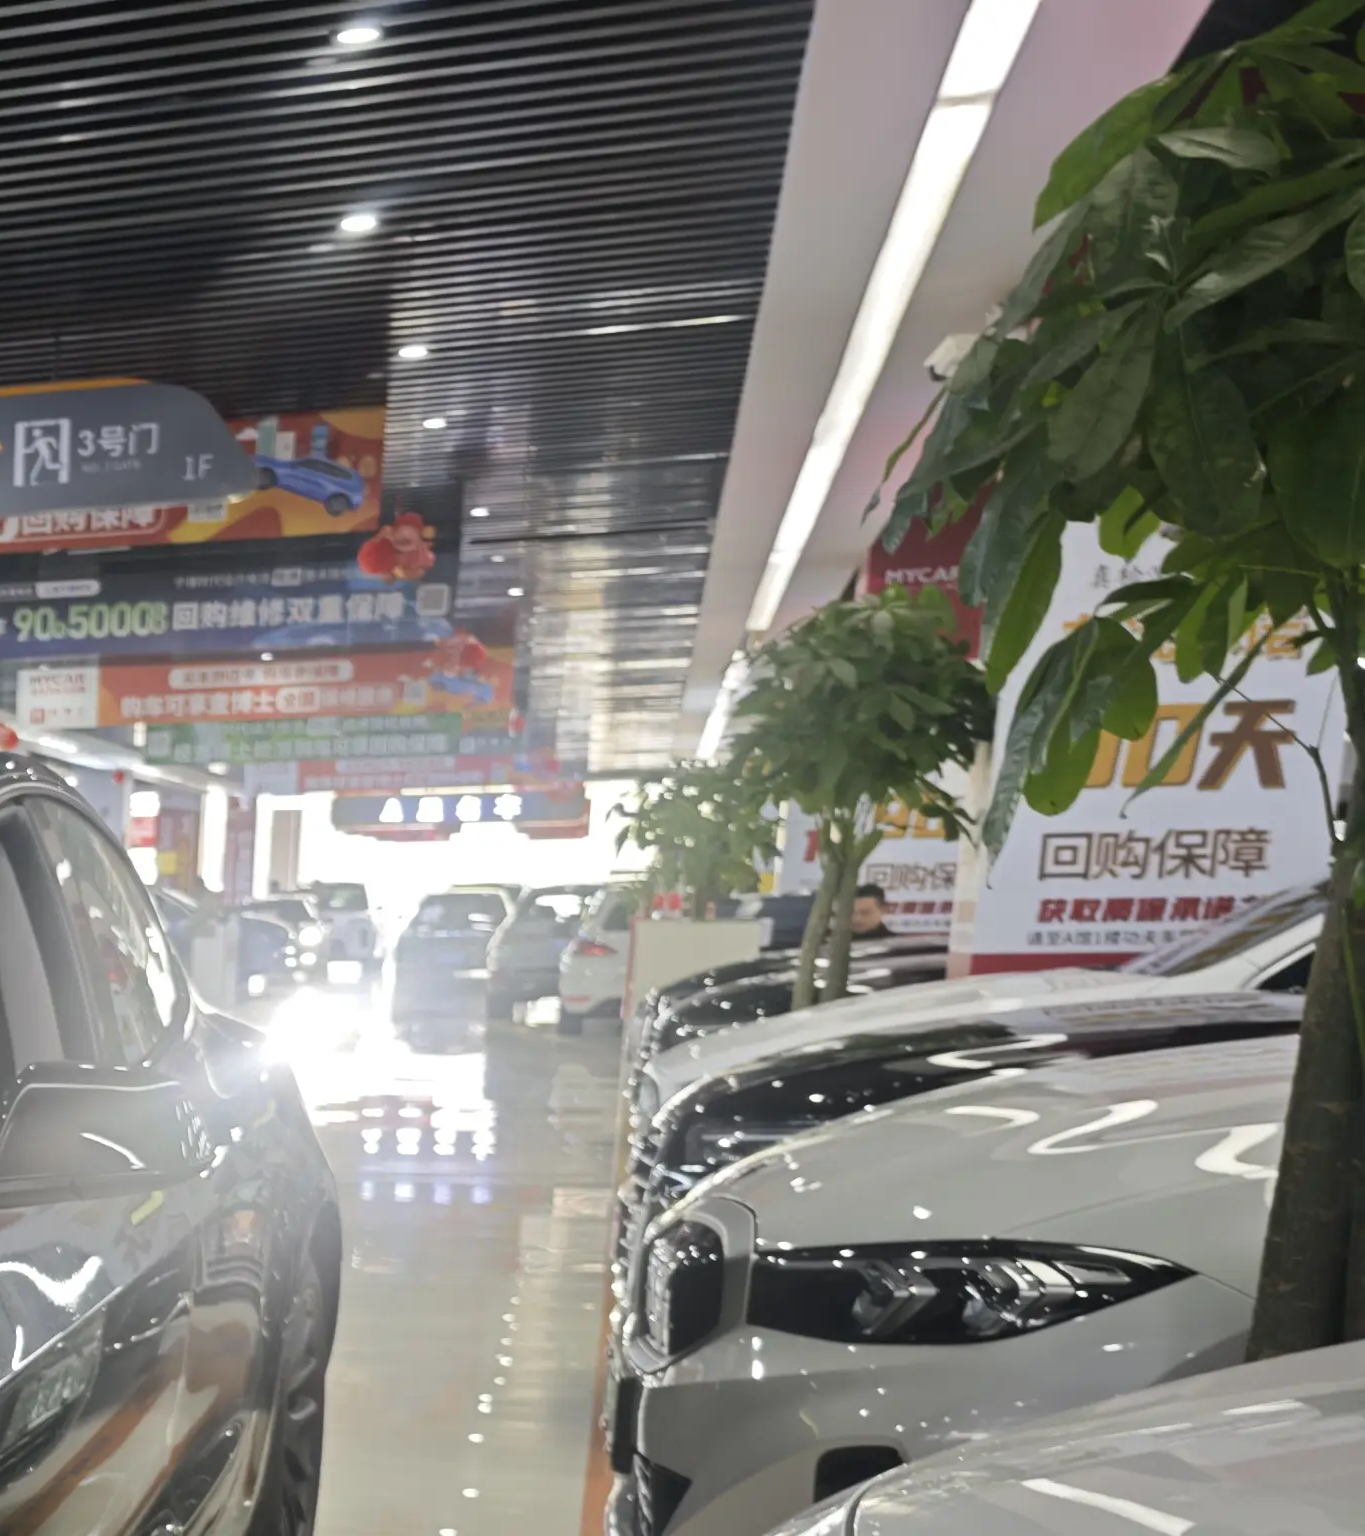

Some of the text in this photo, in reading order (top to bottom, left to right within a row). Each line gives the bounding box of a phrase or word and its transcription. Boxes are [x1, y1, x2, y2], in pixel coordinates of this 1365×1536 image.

[78, 424, 160, 456] 3号门
[182, 454, 215, 480] 1F
[1038, 828, 1271, 881] 回购保障
